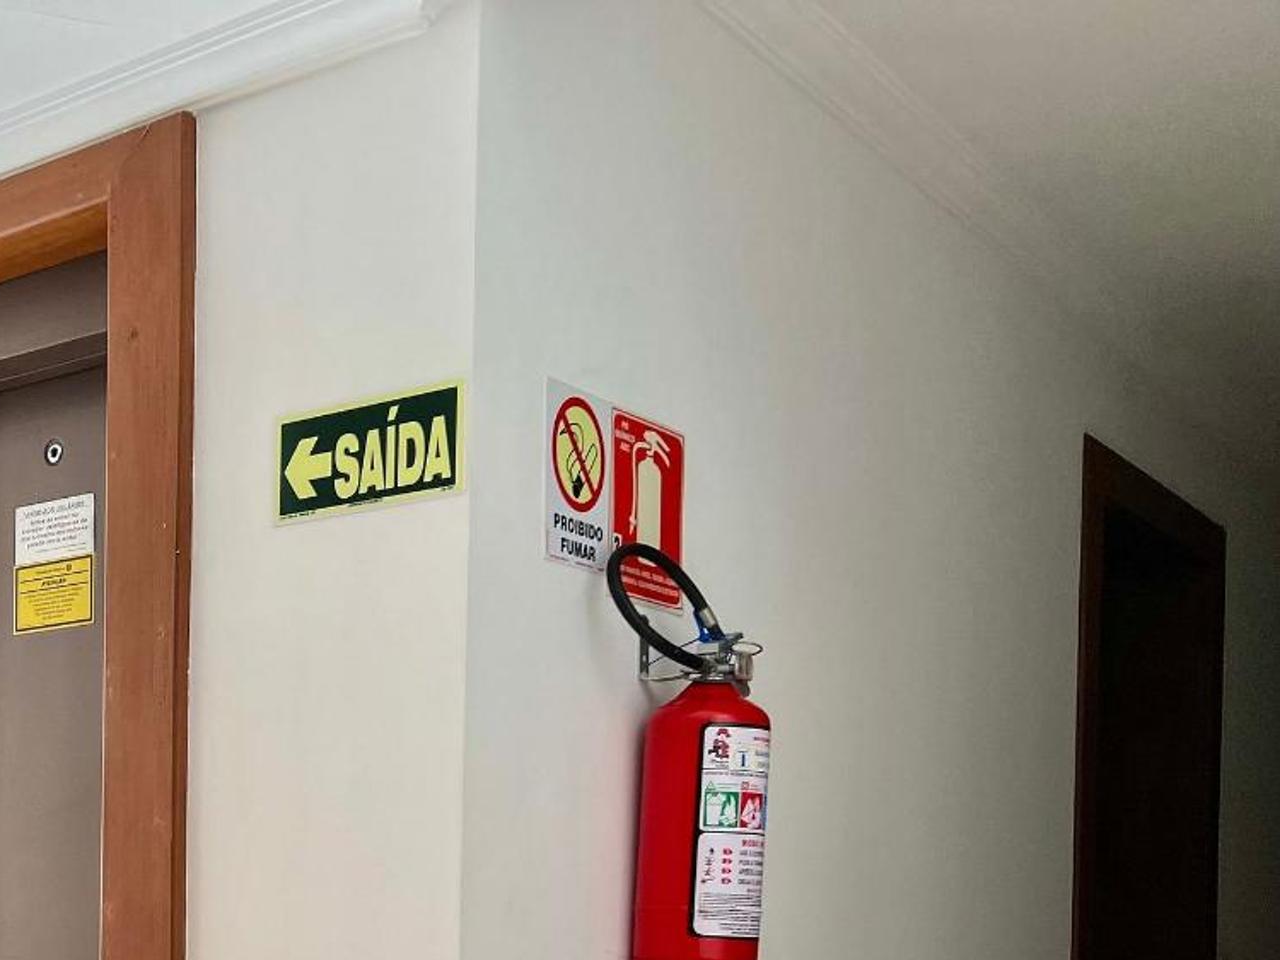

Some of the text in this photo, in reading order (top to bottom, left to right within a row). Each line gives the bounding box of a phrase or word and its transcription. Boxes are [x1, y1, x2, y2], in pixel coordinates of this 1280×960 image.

[334, 405, 451, 500] SAÍDA
[553, 512, 603, 542] PROIBIDO
[560, 537, 597, 561] FUMAR
